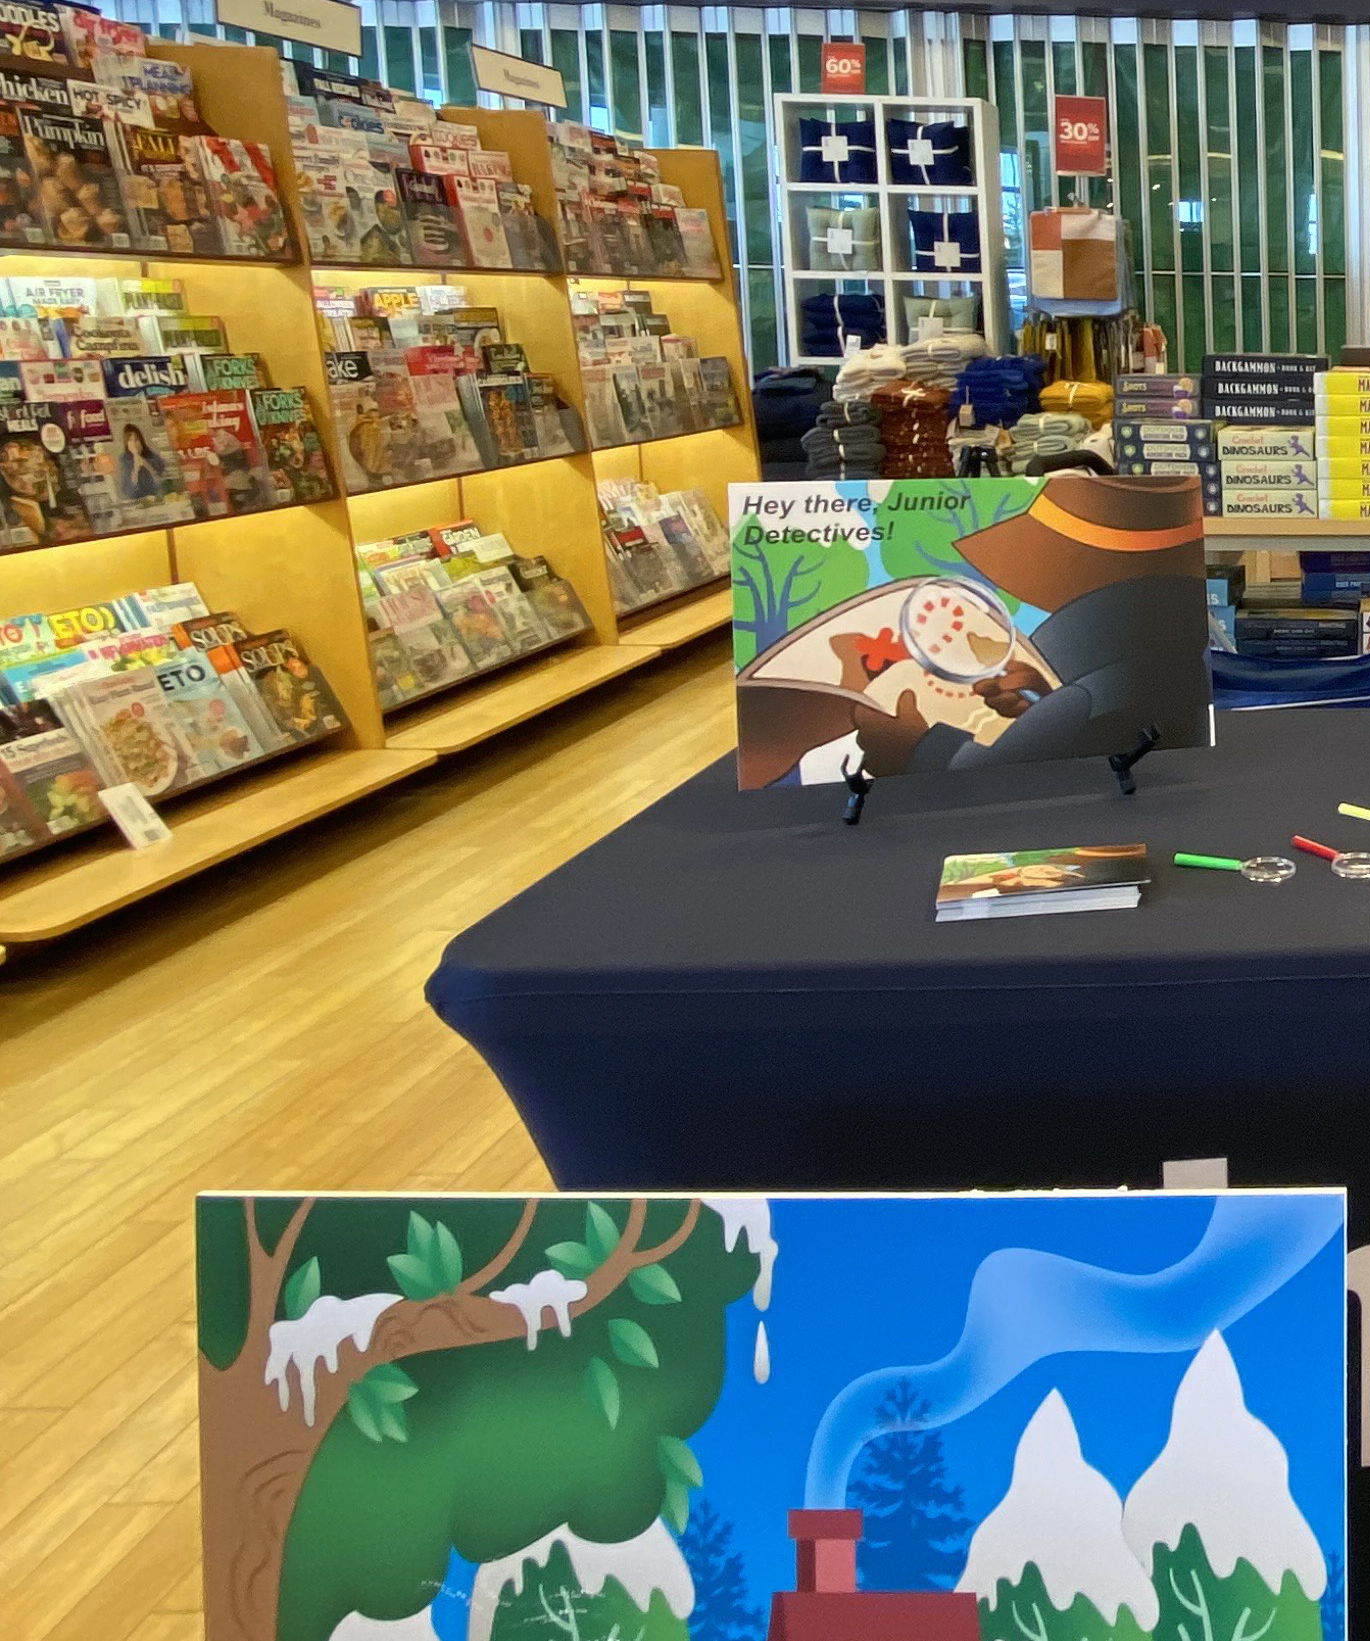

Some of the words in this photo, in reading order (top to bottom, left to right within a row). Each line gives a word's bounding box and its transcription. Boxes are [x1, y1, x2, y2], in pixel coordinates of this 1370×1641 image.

[372, 292, 419, 309] APPLE
[1215, 361, 1276, 374] BACKGAMMON
[117, 362, 187, 390] delish
[1218, 383, 1279, 395] BACKGAMMON
[1215, 405, 1276, 417] BACKGAMMON
[1222, 446, 1288, 456] DINOSAURS
[1226, 475, 1291, 485] DINOSAURS
[743, 496, 795, 519] Hey
[804, 493, 878, 514] there,
[888, 491, 972, 511] Junior
[1226, 504, 1293, 514] DINOSAURS
[744, 521, 895, 546] Detectives!
